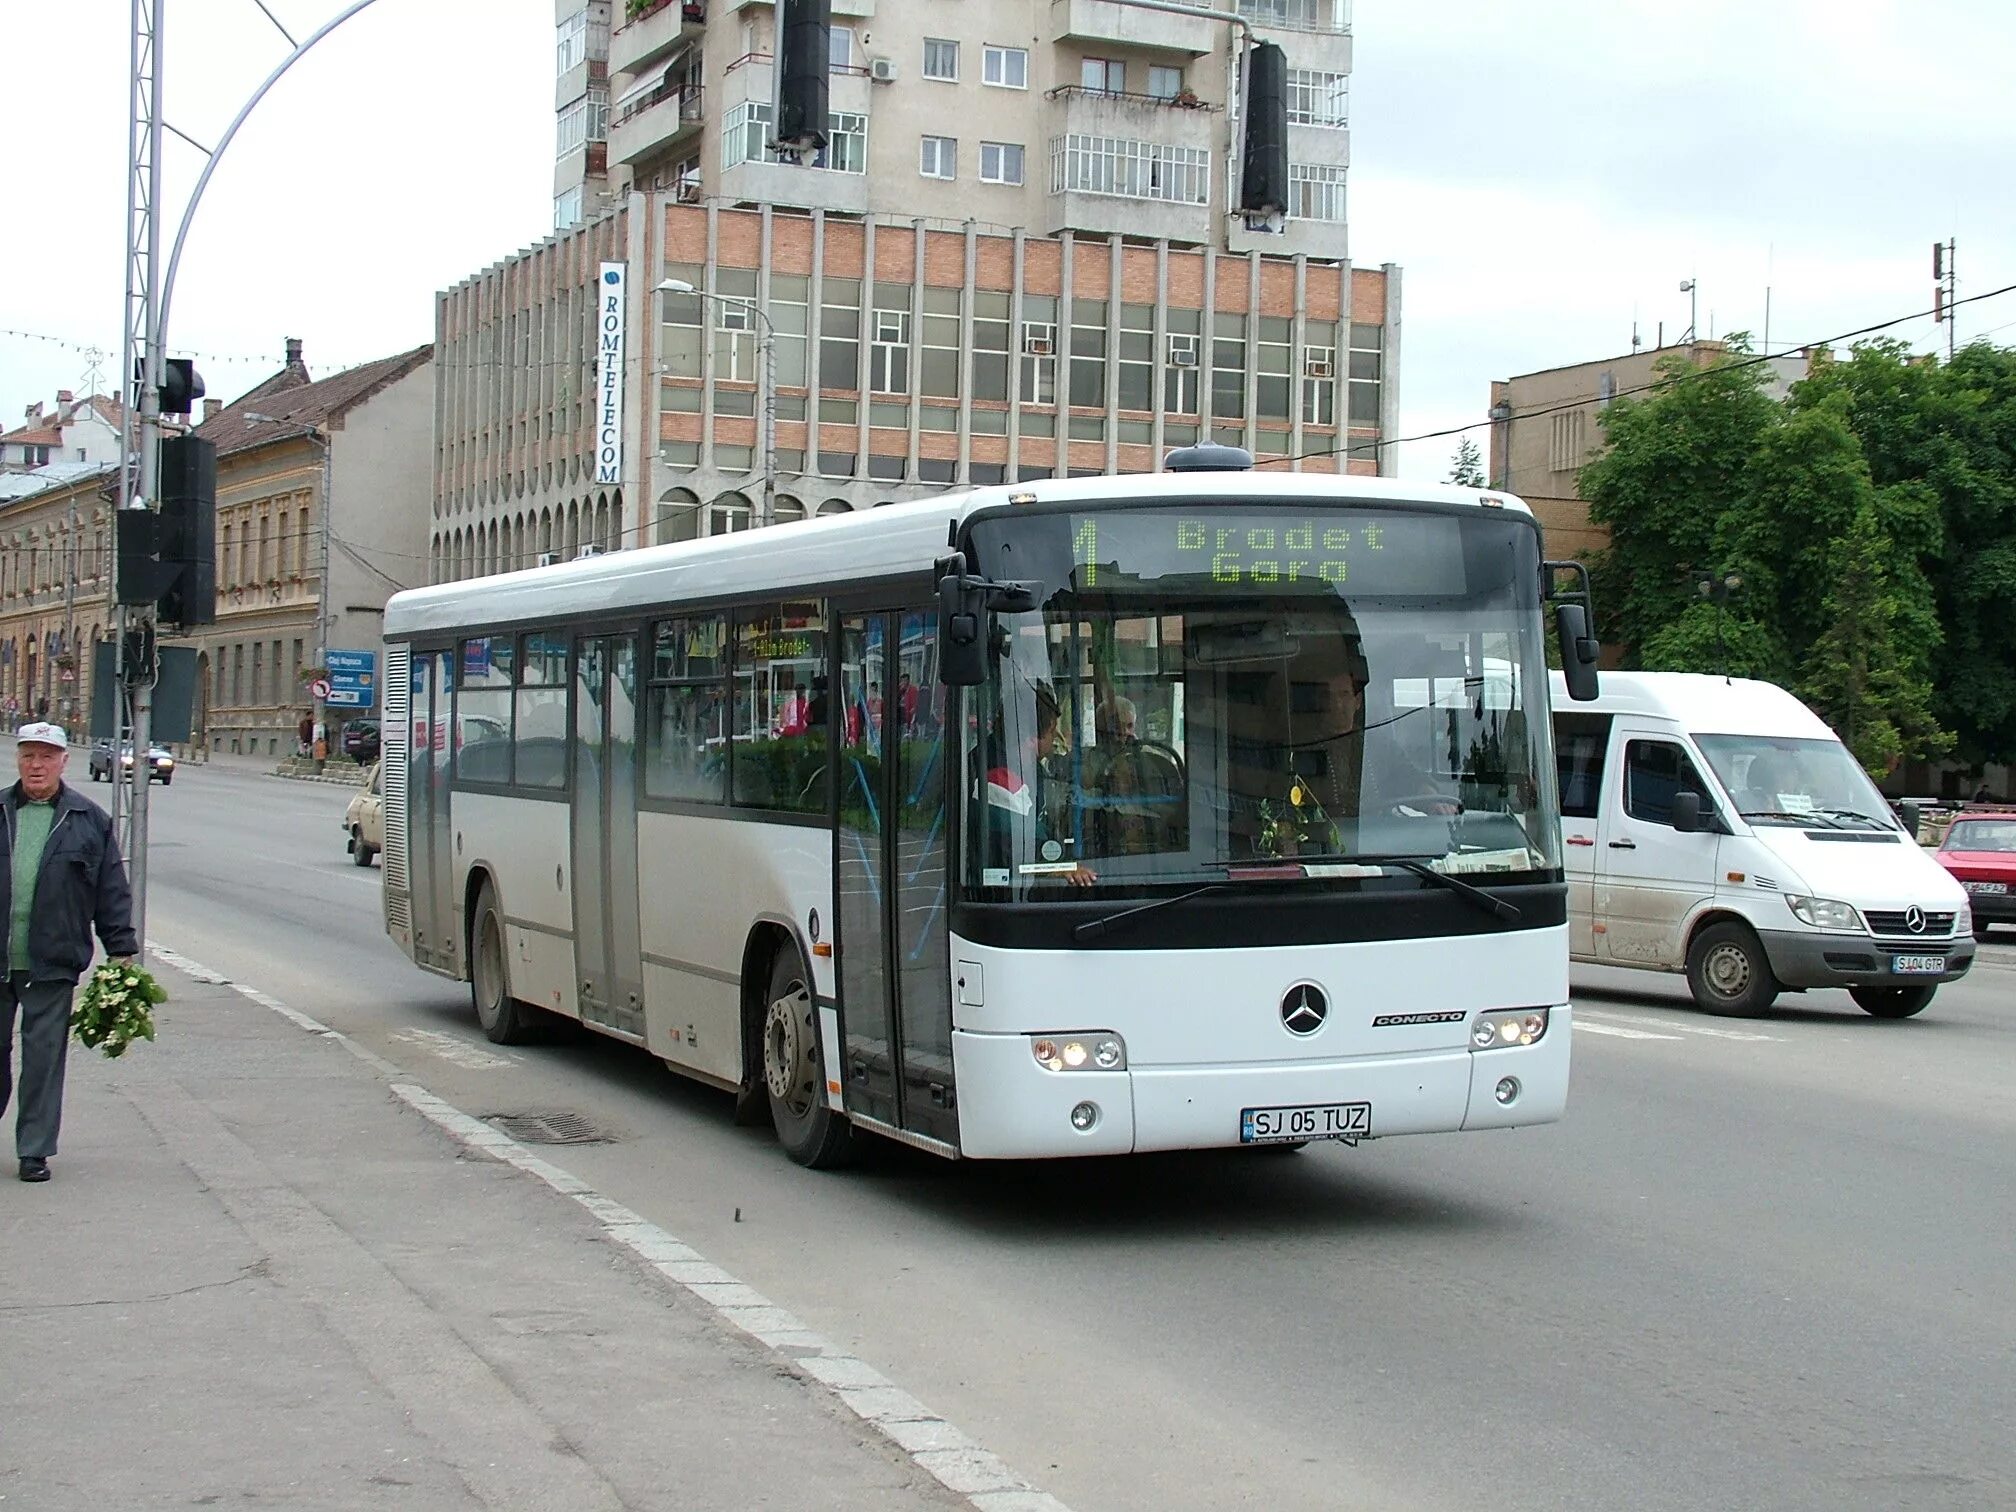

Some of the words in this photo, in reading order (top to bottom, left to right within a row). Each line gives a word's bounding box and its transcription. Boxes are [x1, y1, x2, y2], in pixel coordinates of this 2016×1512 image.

[599, 295, 621, 483] ROMTELECOM
[1072, 518, 1097, 588] 1
[1375, 1011, 1464, 1025] CONECTO
[1255, 1112, 1283, 1135] SJ
[1290, 1110, 1316, 1133] 05
[1323, 1107, 1367, 1131] TUZ
